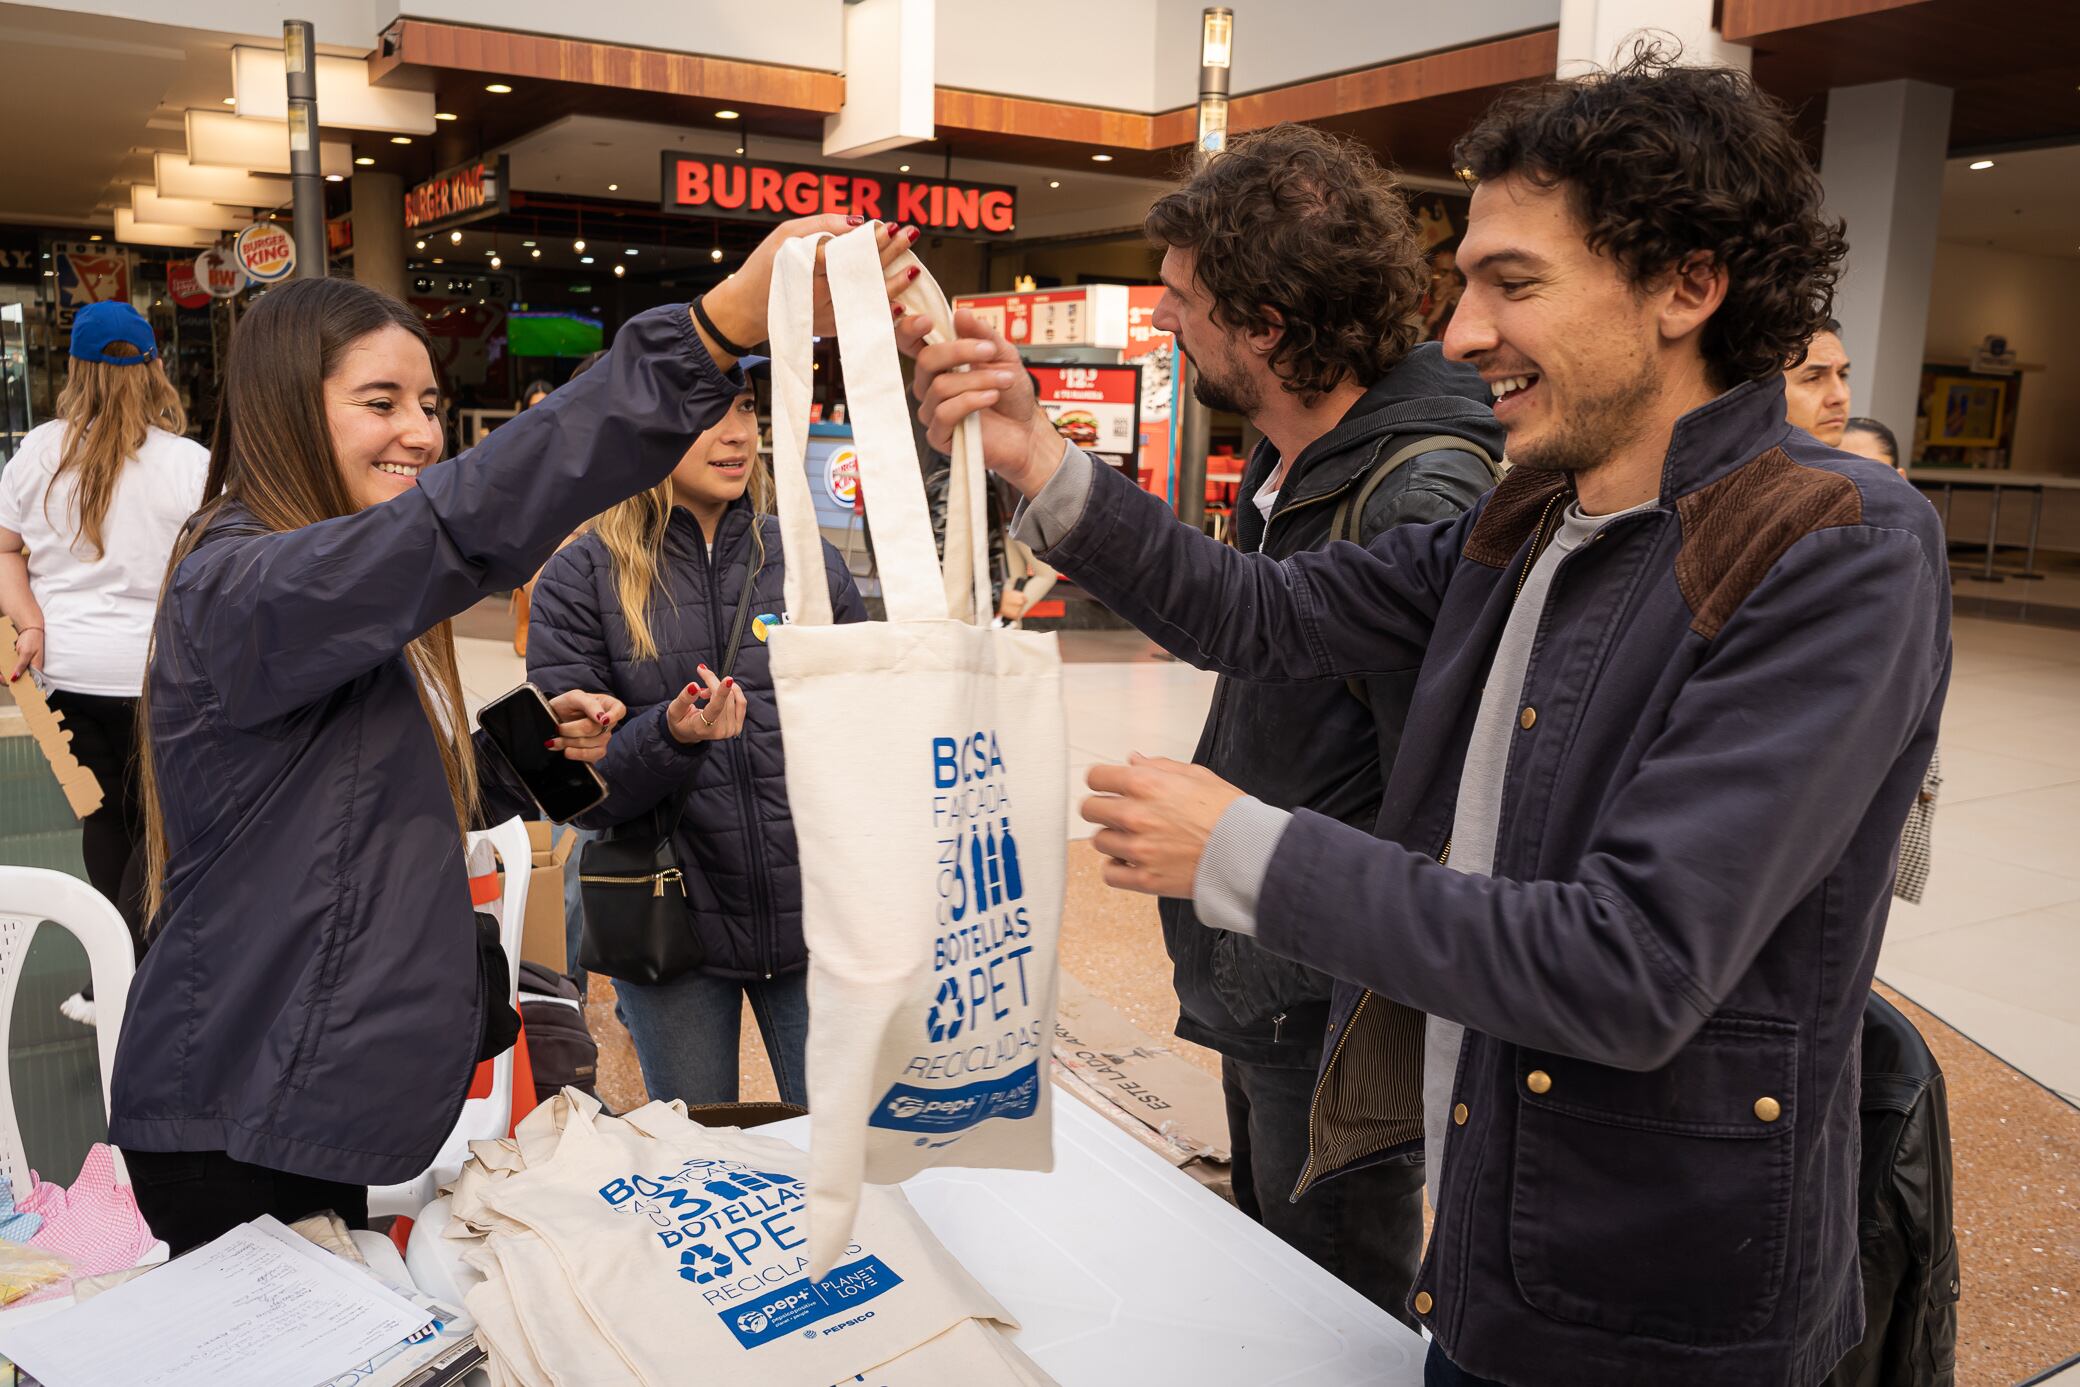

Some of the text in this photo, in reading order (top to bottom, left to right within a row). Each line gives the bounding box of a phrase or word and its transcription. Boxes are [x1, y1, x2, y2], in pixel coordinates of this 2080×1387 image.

[404, 163, 485, 228] BURGER KING
[676, 160, 1014, 232] BURGER KING
[243, 235, 286, 254] BURGER
[246, 245, 289, 268] KING
[935, 907, 1031, 971] BOTELLAS
[969, 945, 1033, 1031] PET
[902, 1020, 1041, 1079] RECICLADAS
[1076, 1051, 1127, 1081] LADO
[1117, 1081, 1172, 1110] ESTE
[652, 1188, 712, 1221] 3
[725, 1204, 807, 1266] PE
[820, 1264, 878, 1293] PLANET
[771, 1277, 878, 1324] pepsicopositive LOVE
[822, 1310, 876, 1336] PEPSICO
